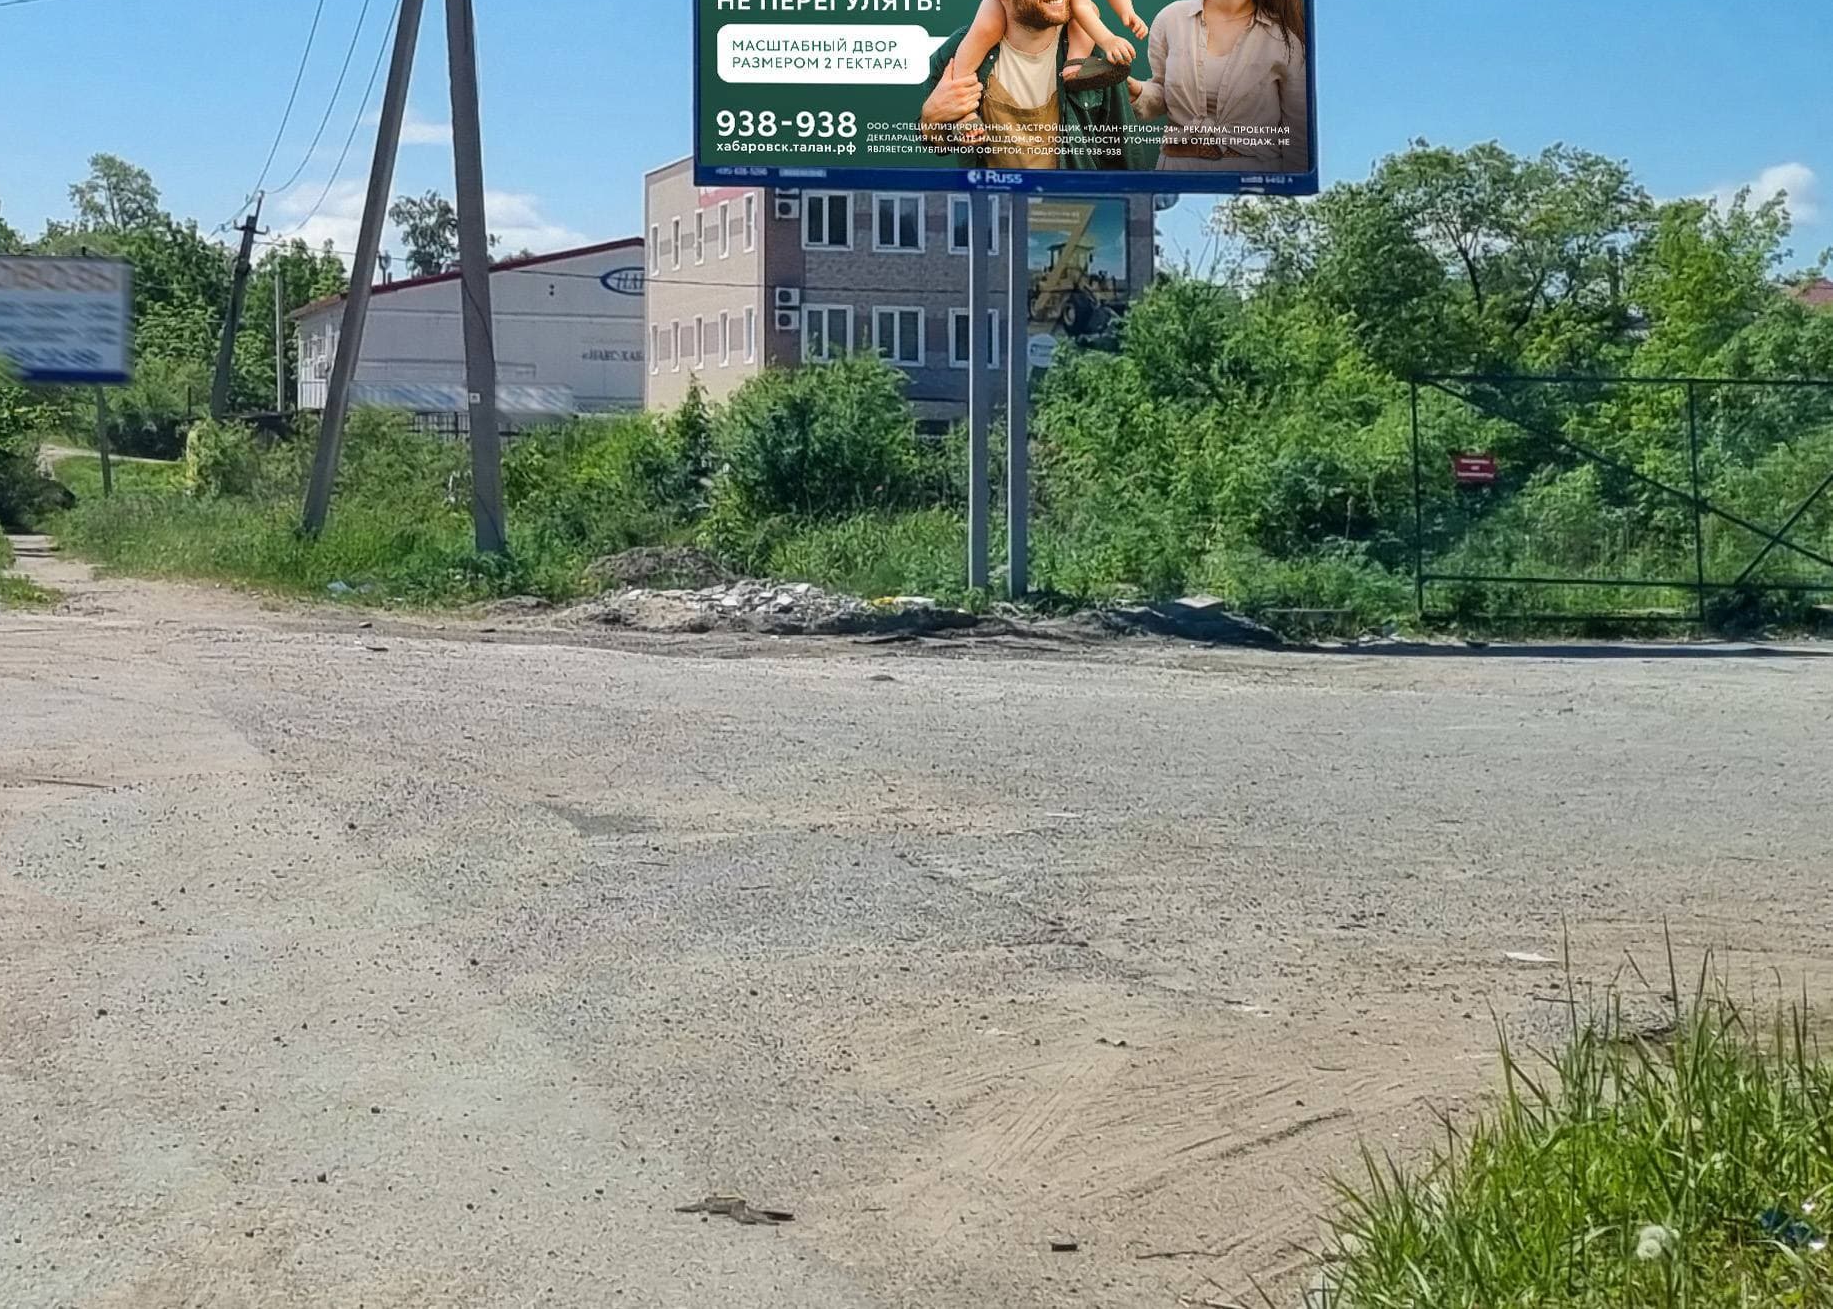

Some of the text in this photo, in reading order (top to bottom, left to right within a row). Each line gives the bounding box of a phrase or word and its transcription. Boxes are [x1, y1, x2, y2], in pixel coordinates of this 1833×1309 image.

[732, 38, 898, 54] МАСШТАБНЫЙ ДВОР
[732, 57, 908, 70] РАЗМЕРОМ 2 ГЕКТАРА!
[716, 110, 858, 138] 938-938
[867, 122, 889, 130] ООО
[892, 122, 1012, 132] «СПЕЦИАЛИЗИРОВАННЫЙ
[1015, 123, 1081, 132] ЗАСТРОЙЩИК
[1183, 125, 1231, 134] РЕКЛАМА.
[1233, 125, 1290, 134] ПРОЕКТНАЯ
[866, 134, 927, 142] ДЕКЛАРАЦИЯ
[931, 134, 944, 142] НА
[946, 132, 976, 142] САЙТЕ
[1048, 136, 1120, 144] ПОДРОБНОСТИ
[1123, 136, 1178, 145] УТОЧНЯЙТЕ
[1181, 137, 1188, 145] В
[1191, 137, 1227, 146] ОТДЕЛЕ
[1230, 138, 1275, 146] ПРОДАЖ.
[1278, 138, 1290, 146] НЕ
[716, 141, 857, 155] хабаровск.талан.рф
[867, 145, 1122, 156] ЯВЛЯЕТСЯ ПУБЛИЧНОЙ ОФЕРТОЙ. ПОДРОБНЕЕ 938-938
[985, 170, 1023, 184] Russ
